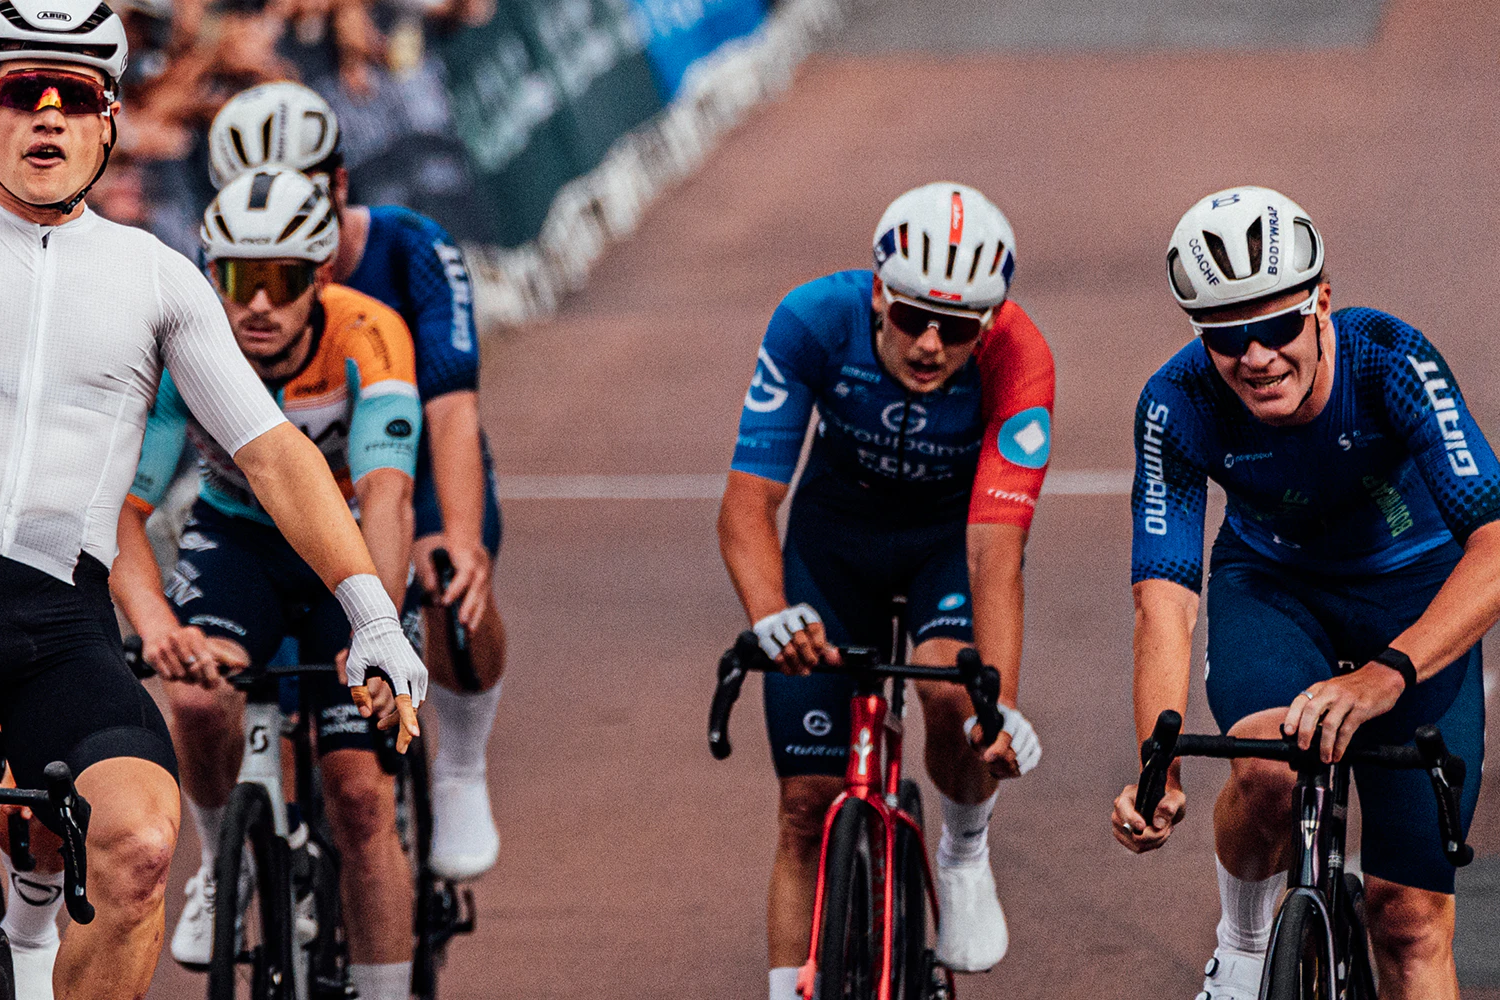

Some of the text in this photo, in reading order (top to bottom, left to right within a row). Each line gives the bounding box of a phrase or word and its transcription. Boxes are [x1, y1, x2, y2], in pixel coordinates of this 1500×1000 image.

[41, 12, 68, 21] ABUS
[1267, 206, 1280, 276] BODYWRAP
[1406, 354, 1480, 477] GIANT
[1143, 400, 1169, 536] SHIMANO
